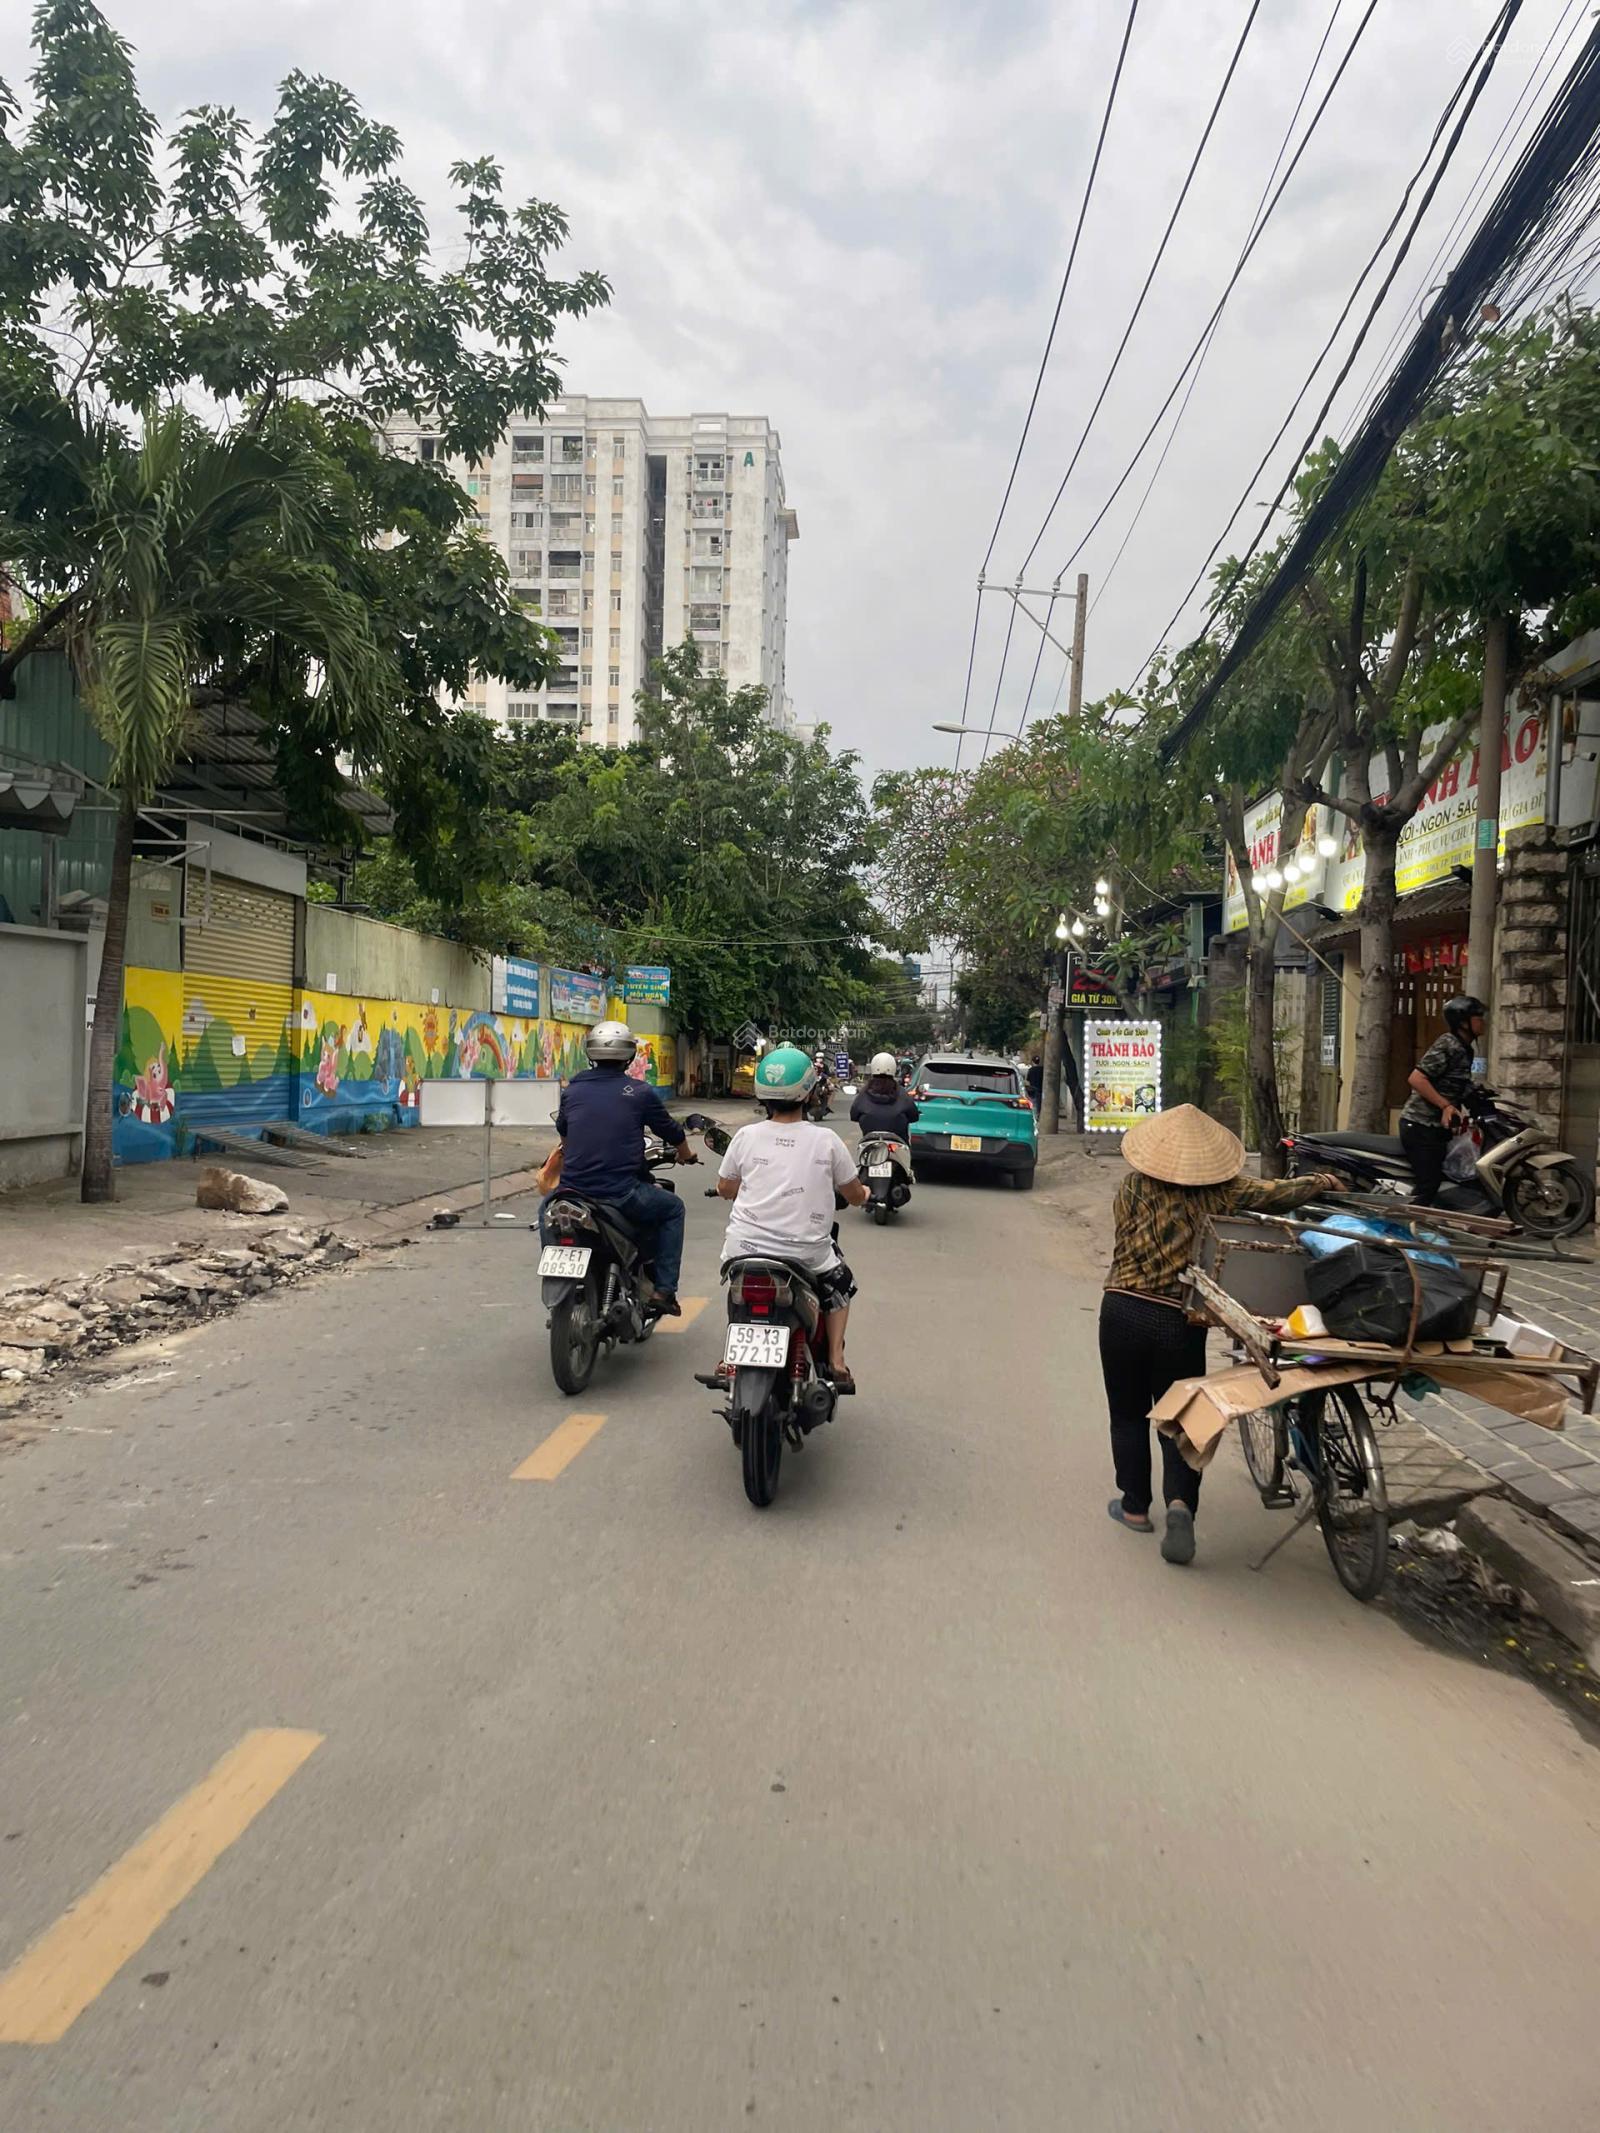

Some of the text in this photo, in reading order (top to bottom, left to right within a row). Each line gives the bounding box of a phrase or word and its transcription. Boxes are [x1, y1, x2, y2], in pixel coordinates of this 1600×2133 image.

[744, 451, 754, 467] A
[1421, 810, 1450, 833] NGON
[550, 1249, 582, 1262] 77-E1
[541, 1262, 584, 1276] 085.30
[736, 1327, 780, 1345] 59-X3
[728, 1345, 784, 1364] 572.15
